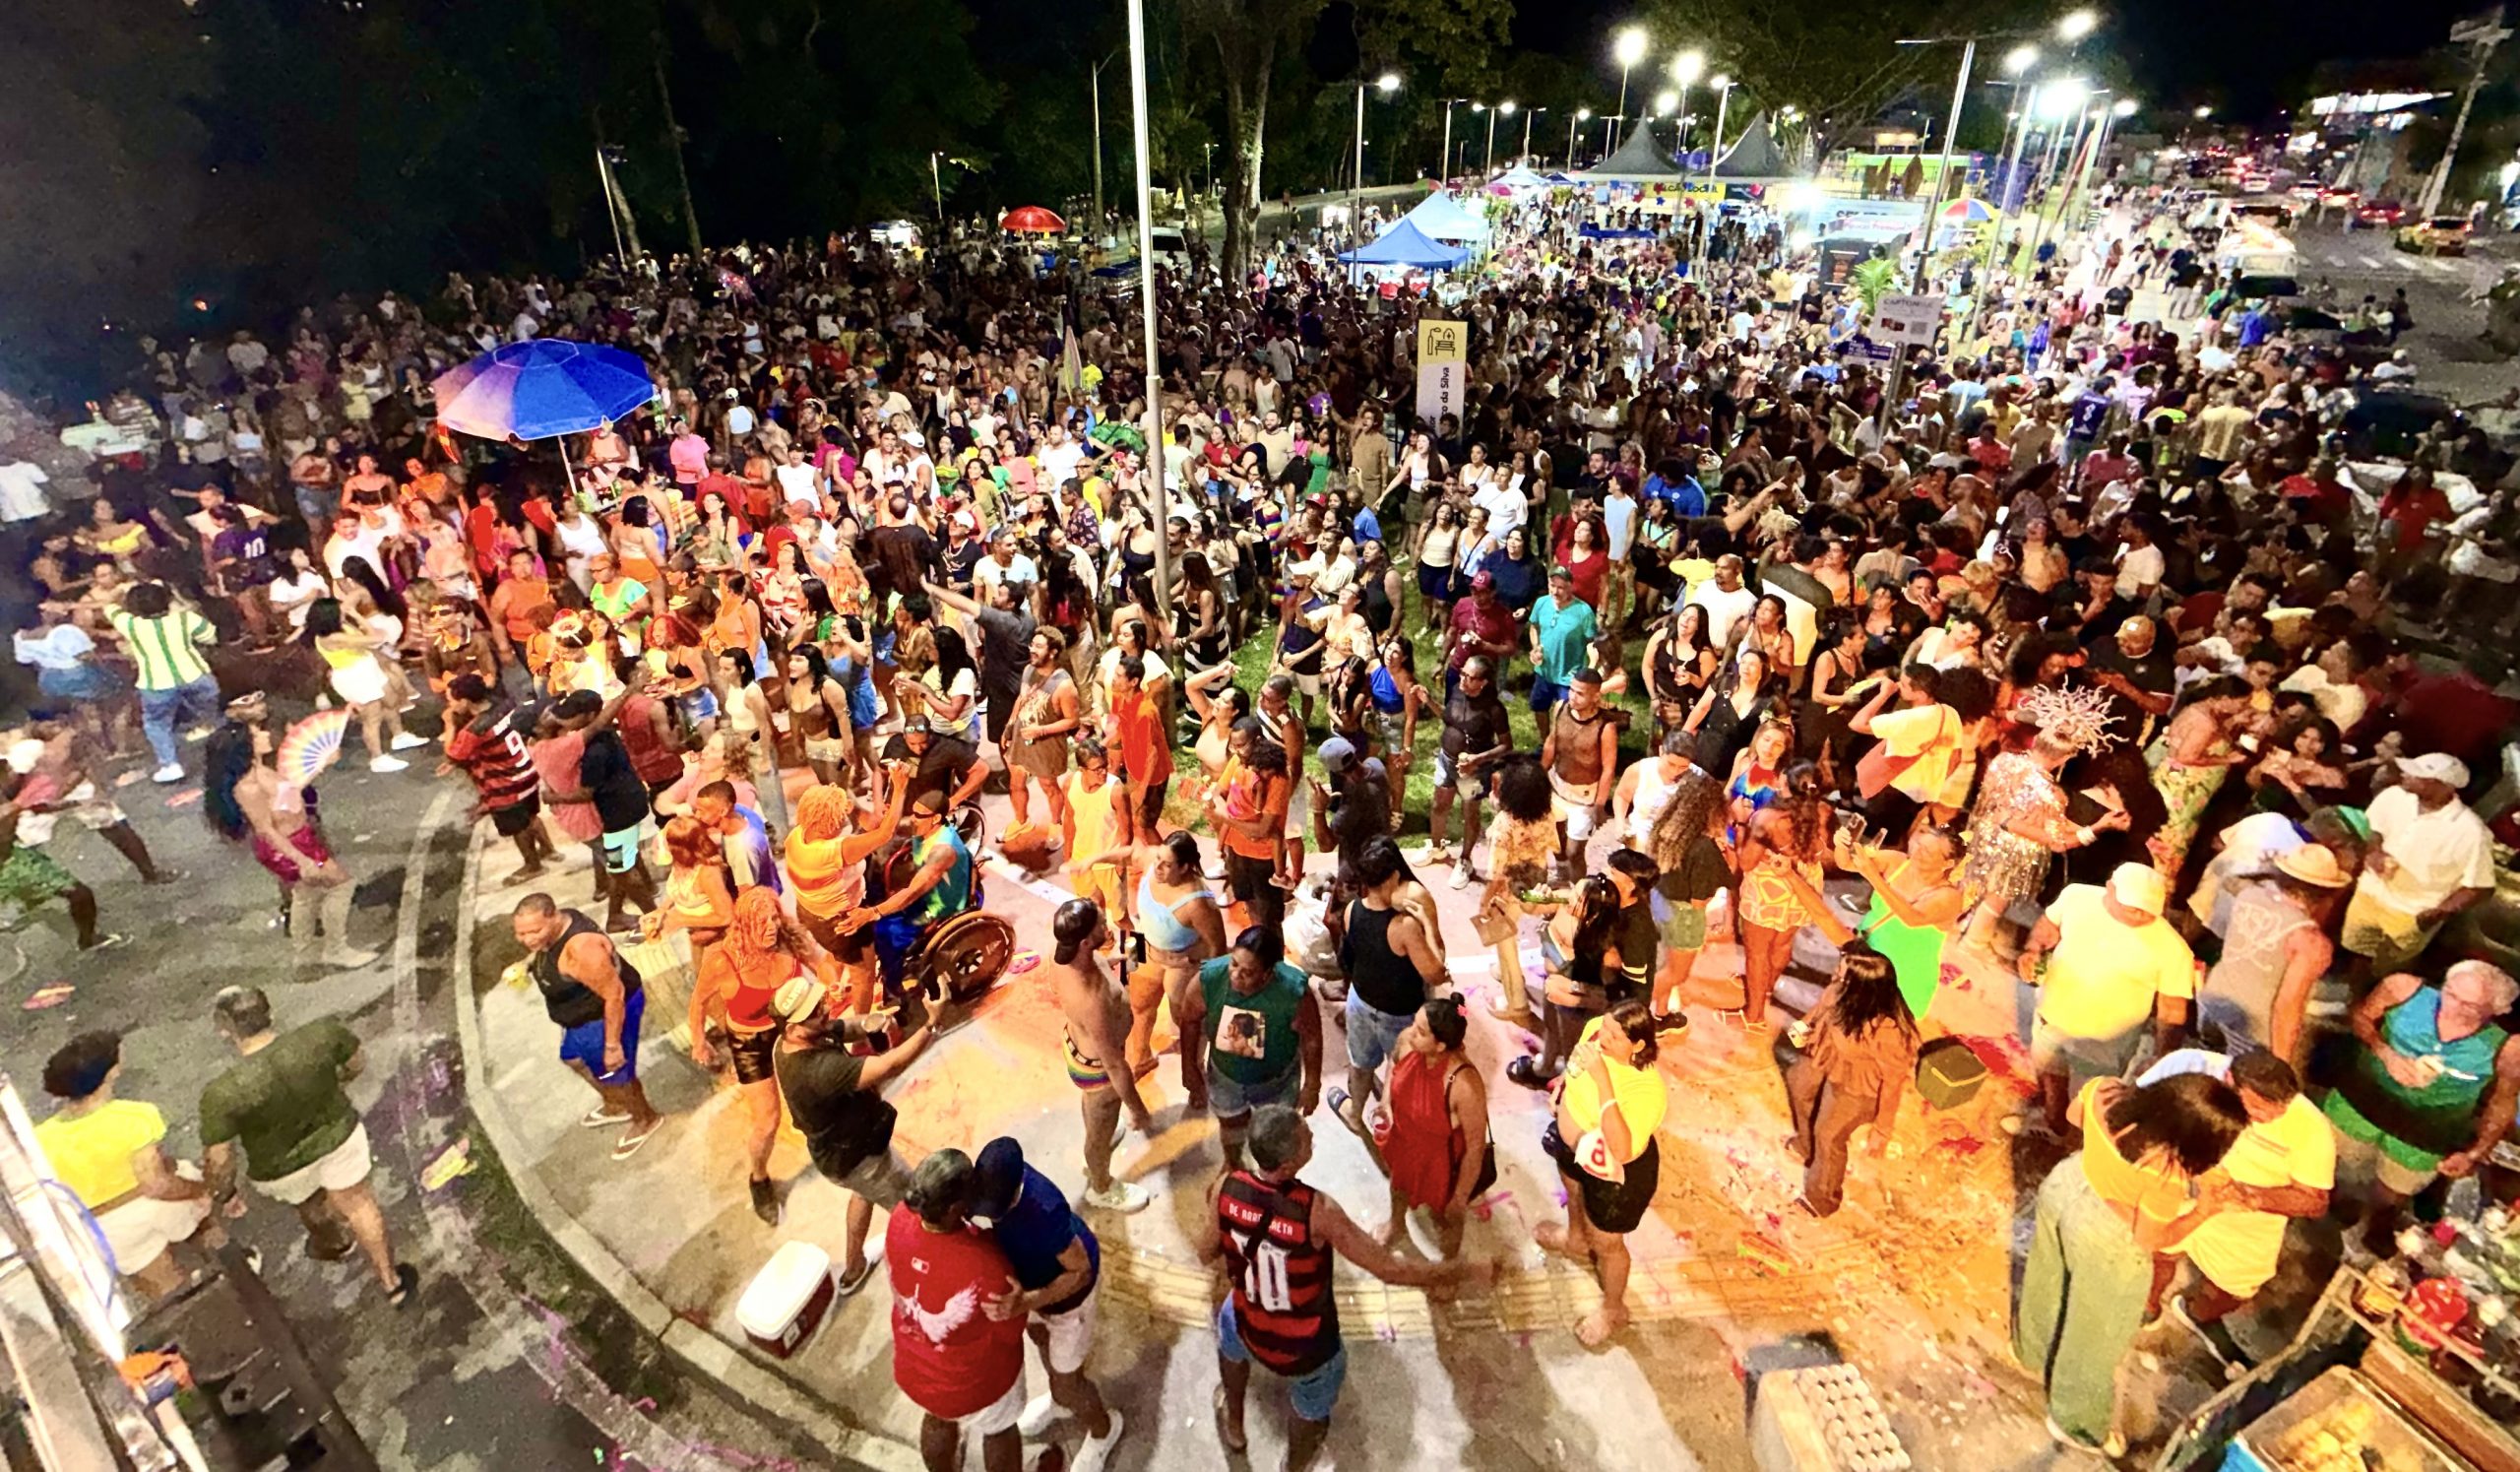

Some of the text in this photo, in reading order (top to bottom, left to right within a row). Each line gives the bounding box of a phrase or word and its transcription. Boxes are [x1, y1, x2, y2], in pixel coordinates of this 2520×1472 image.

[1440, 366, 1450, 389] Silva
[1440, 392, 1448, 404] da
[244, 537, 266, 559] 10
[504, 730, 532, 768] 9
[1228, 1202, 1239, 1217] DE
